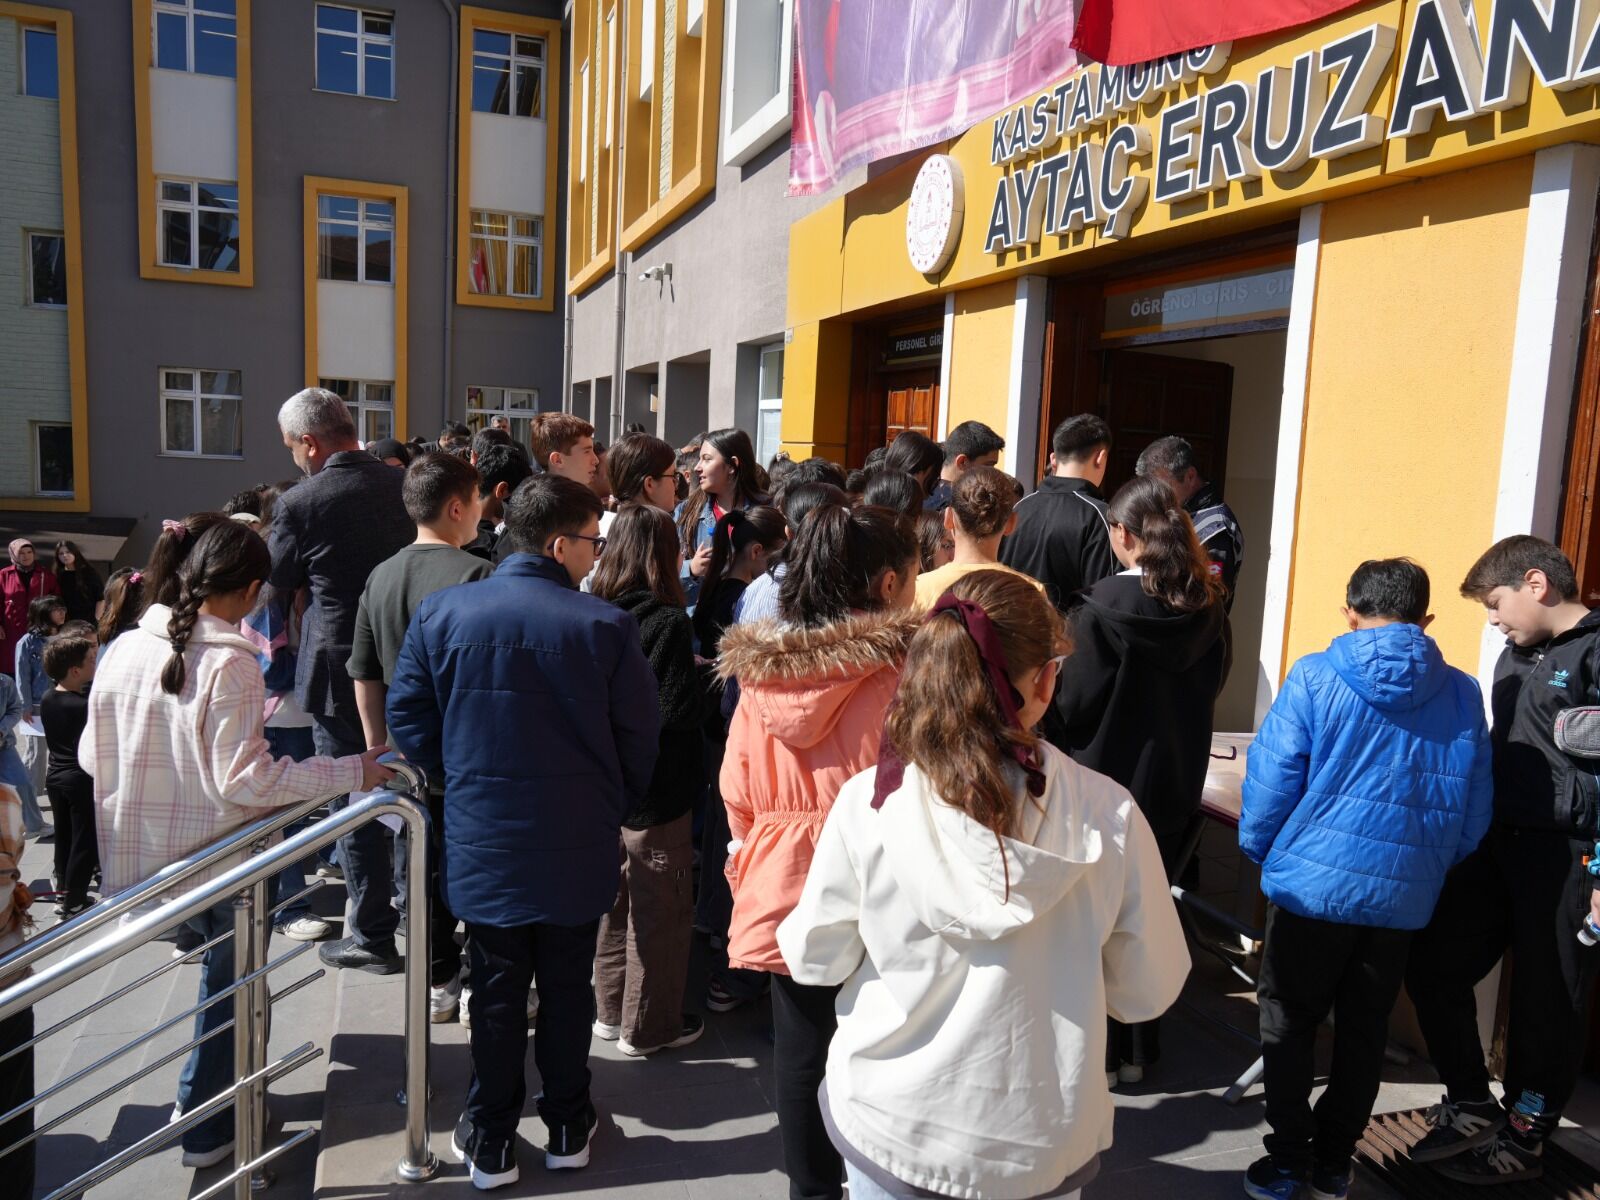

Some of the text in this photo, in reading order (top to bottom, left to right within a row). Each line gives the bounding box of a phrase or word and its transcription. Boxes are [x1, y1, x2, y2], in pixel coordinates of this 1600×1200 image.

[983, 123, 1138, 254] AYTAÇ
[1155, 22, 1379, 203] ERUZ
[1130, 288, 1197, 317] ÖĞRENCİ
[895, 336, 928, 352] PERSONEL
